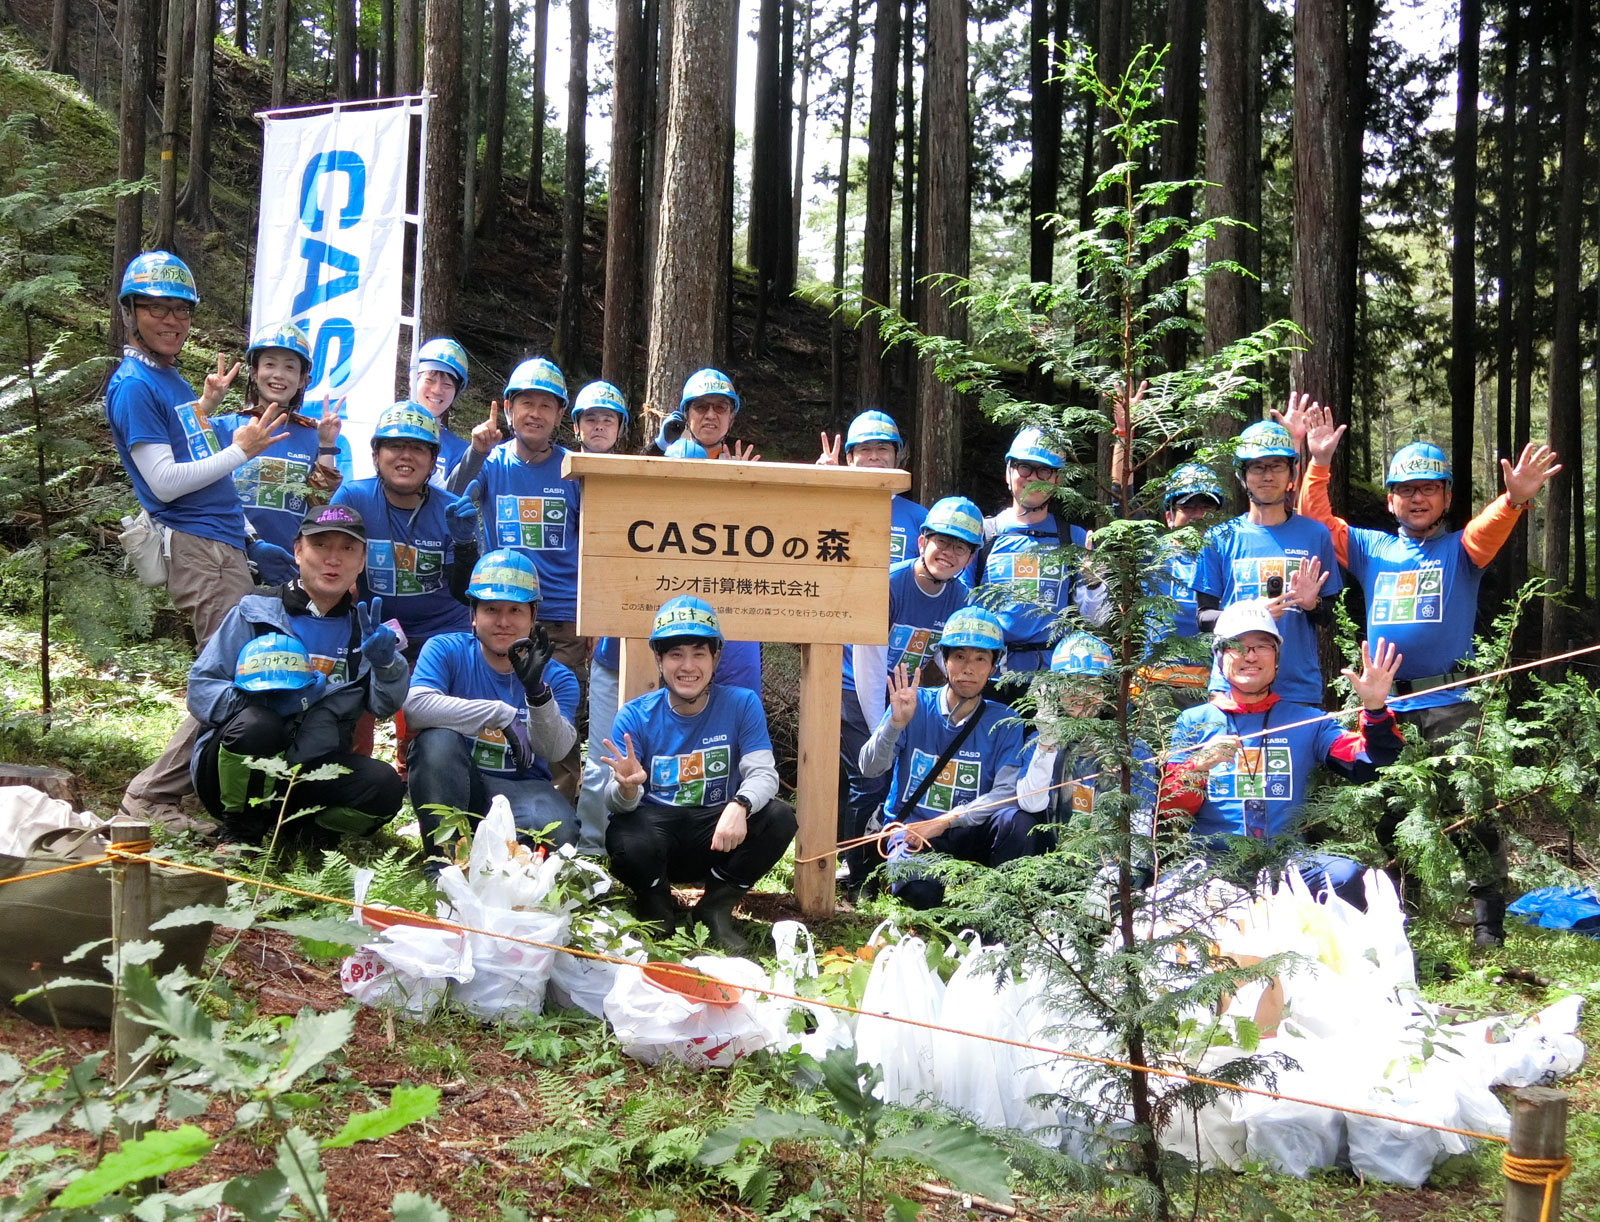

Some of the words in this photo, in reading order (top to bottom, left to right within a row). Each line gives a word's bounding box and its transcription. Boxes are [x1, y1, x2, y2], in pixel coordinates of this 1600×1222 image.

[287, 452, 311, 461] CASIO
[415, 539, 442, 548] CASIO
[627, 520, 851, 563] CASIOの森
[1284, 548, 1309, 557] CASIO
[655, 574, 820, 598] カシオ計算機株式会社
[702, 734, 728, 745] CASIO
[958, 750, 981, 758] CASO
